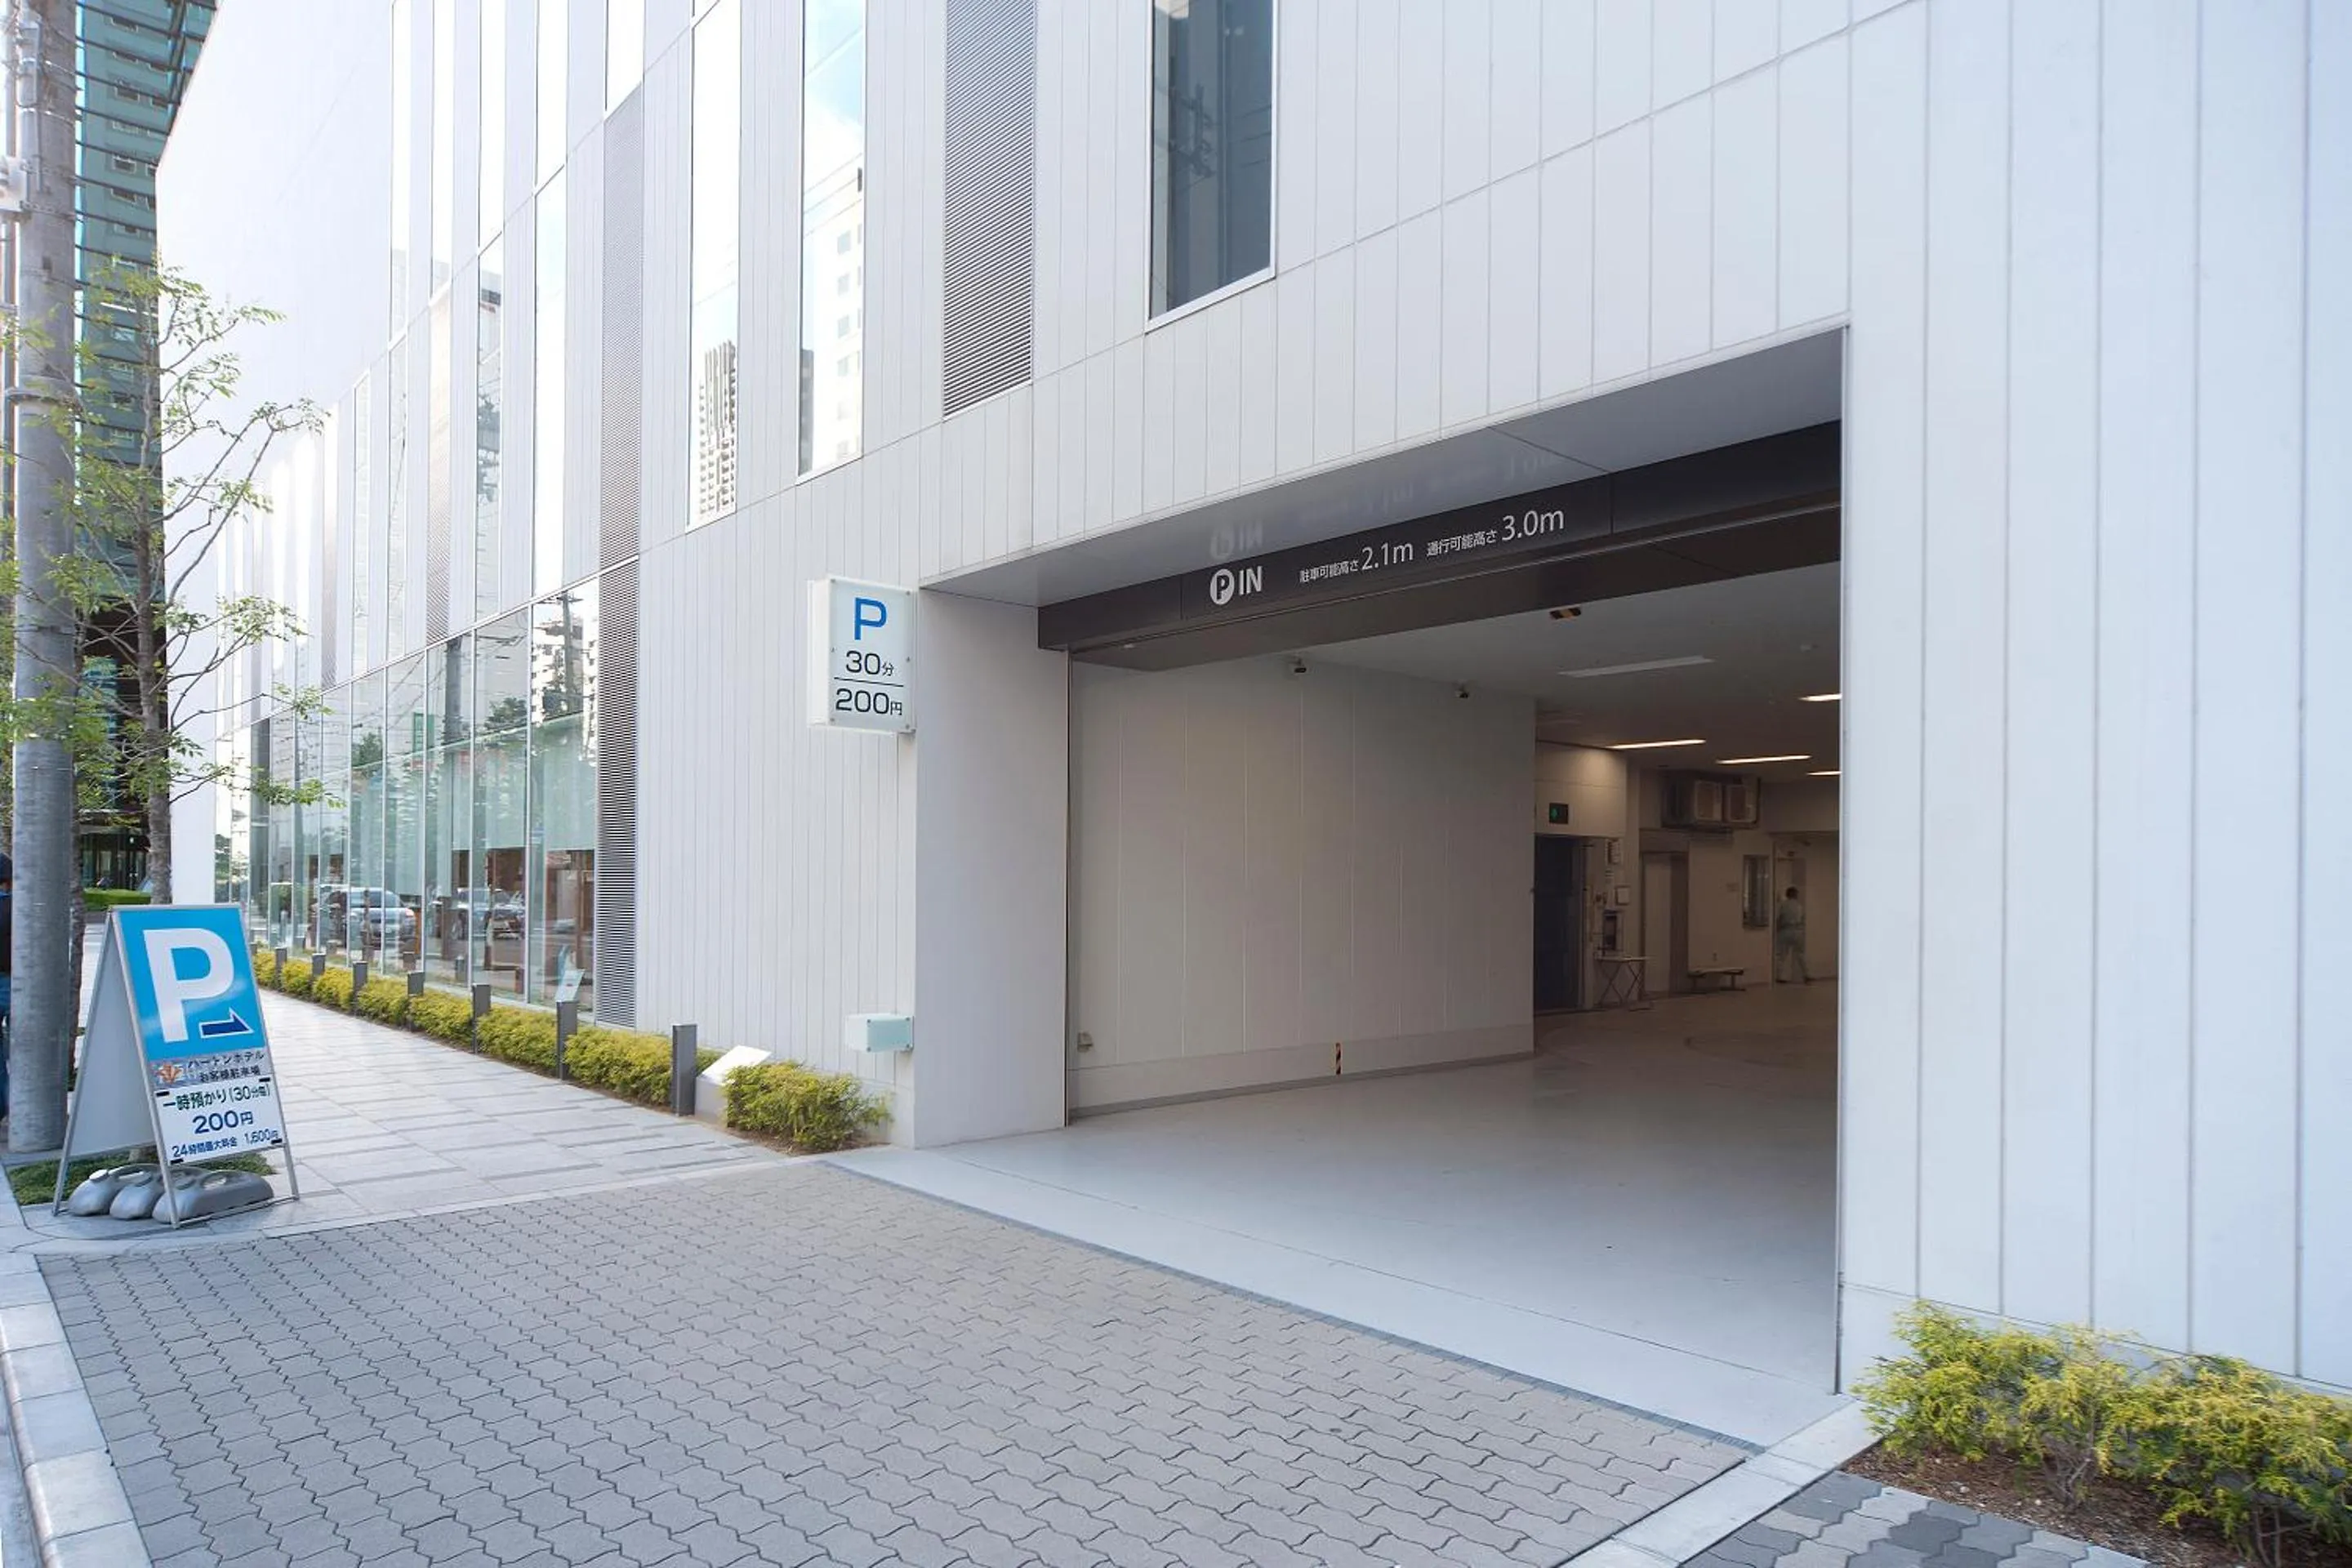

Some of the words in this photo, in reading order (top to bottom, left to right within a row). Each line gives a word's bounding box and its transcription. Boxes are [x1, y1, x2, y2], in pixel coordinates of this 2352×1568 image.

[1427, 530, 1497, 557] 通行可能高さ
[1502, 509, 1565, 541] 3.0m
[1299, 559, 1359, 582] 駐車可能高さ
[1361, 542, 1414, 571] 2.1m
[1239, 566, 1263, 595] IN
[854, 597, 888, 640] P
[846, 650, 894, 676] 30分
[835, 688, 902, 716] 200円
[143, 927, 234, 1044] P
[188, 1050, 265, 1069] ハートンホテル
[192, 1110, 253, 1134] 200円
